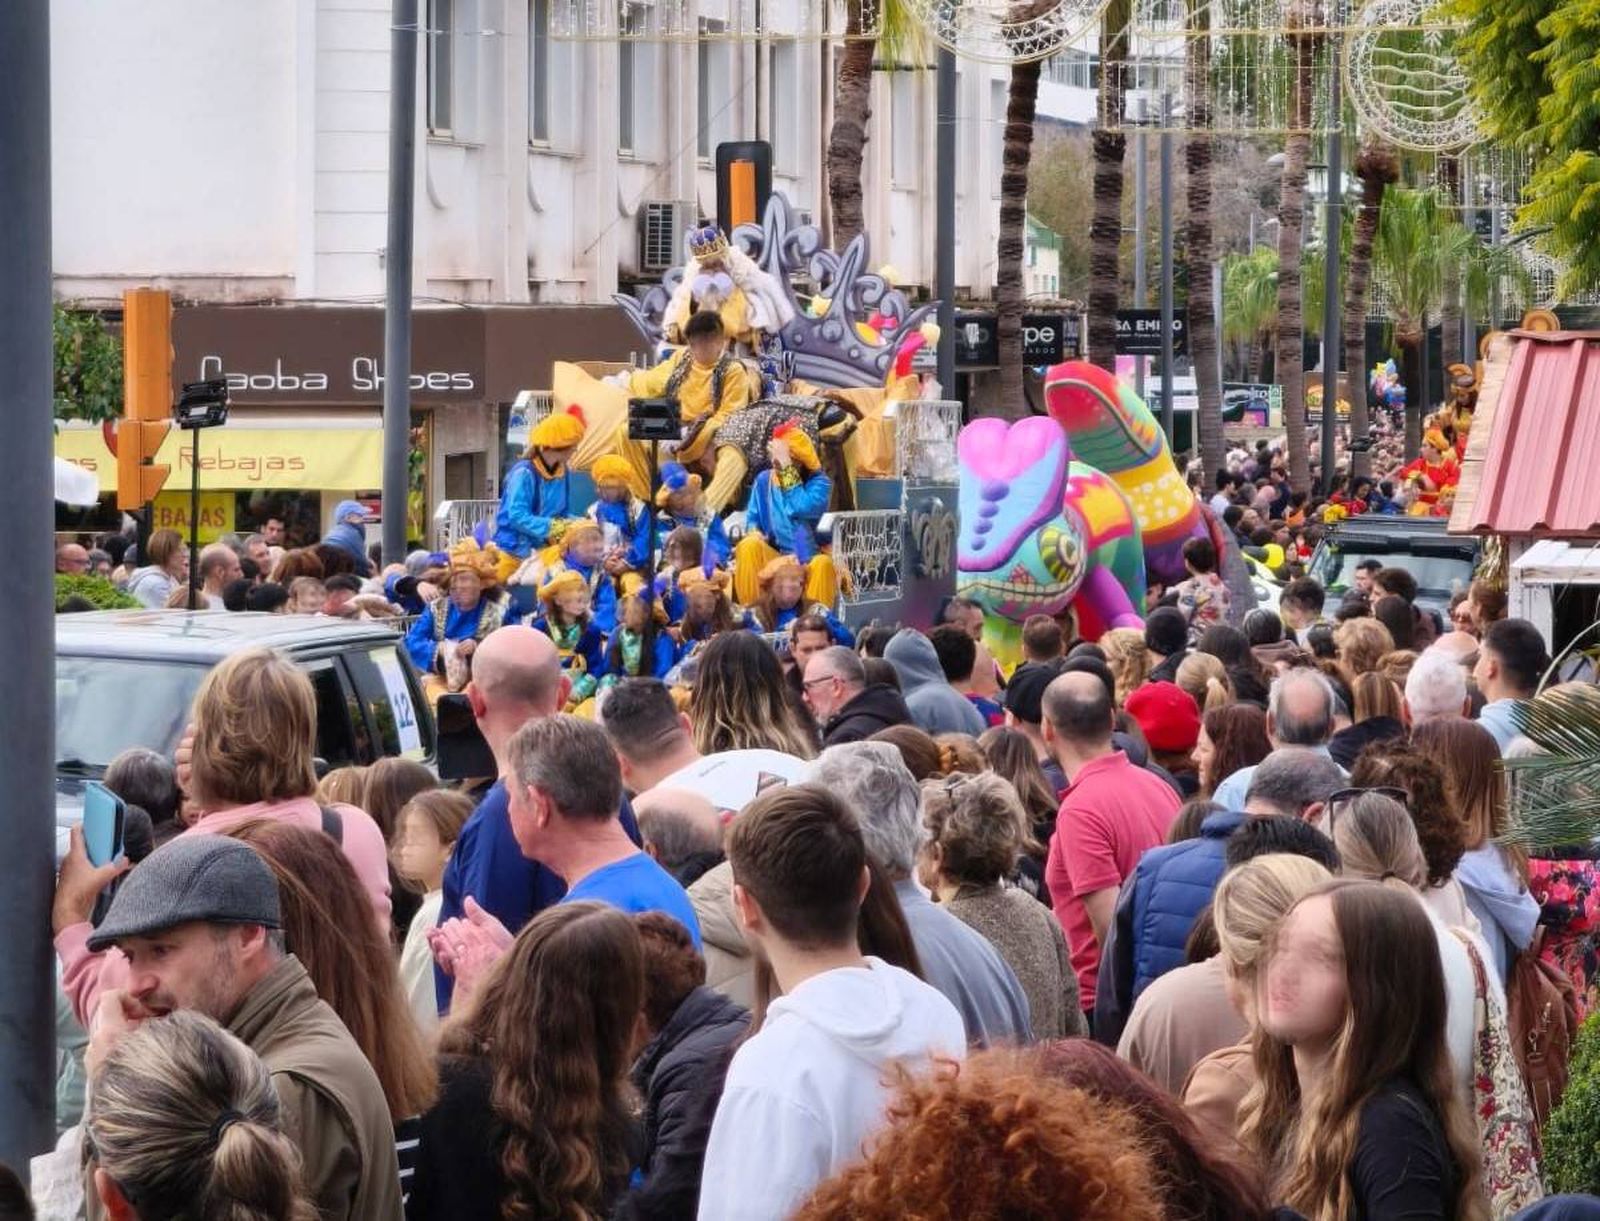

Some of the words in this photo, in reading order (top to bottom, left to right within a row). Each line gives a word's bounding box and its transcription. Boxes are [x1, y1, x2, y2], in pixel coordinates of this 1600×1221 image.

[1022, 327, 1055, 347] pe
[1136, 320, 1183, 331] EMIO
[179, 446, 305, 481] Rebajas
[394, 692, 414, 728] 12
